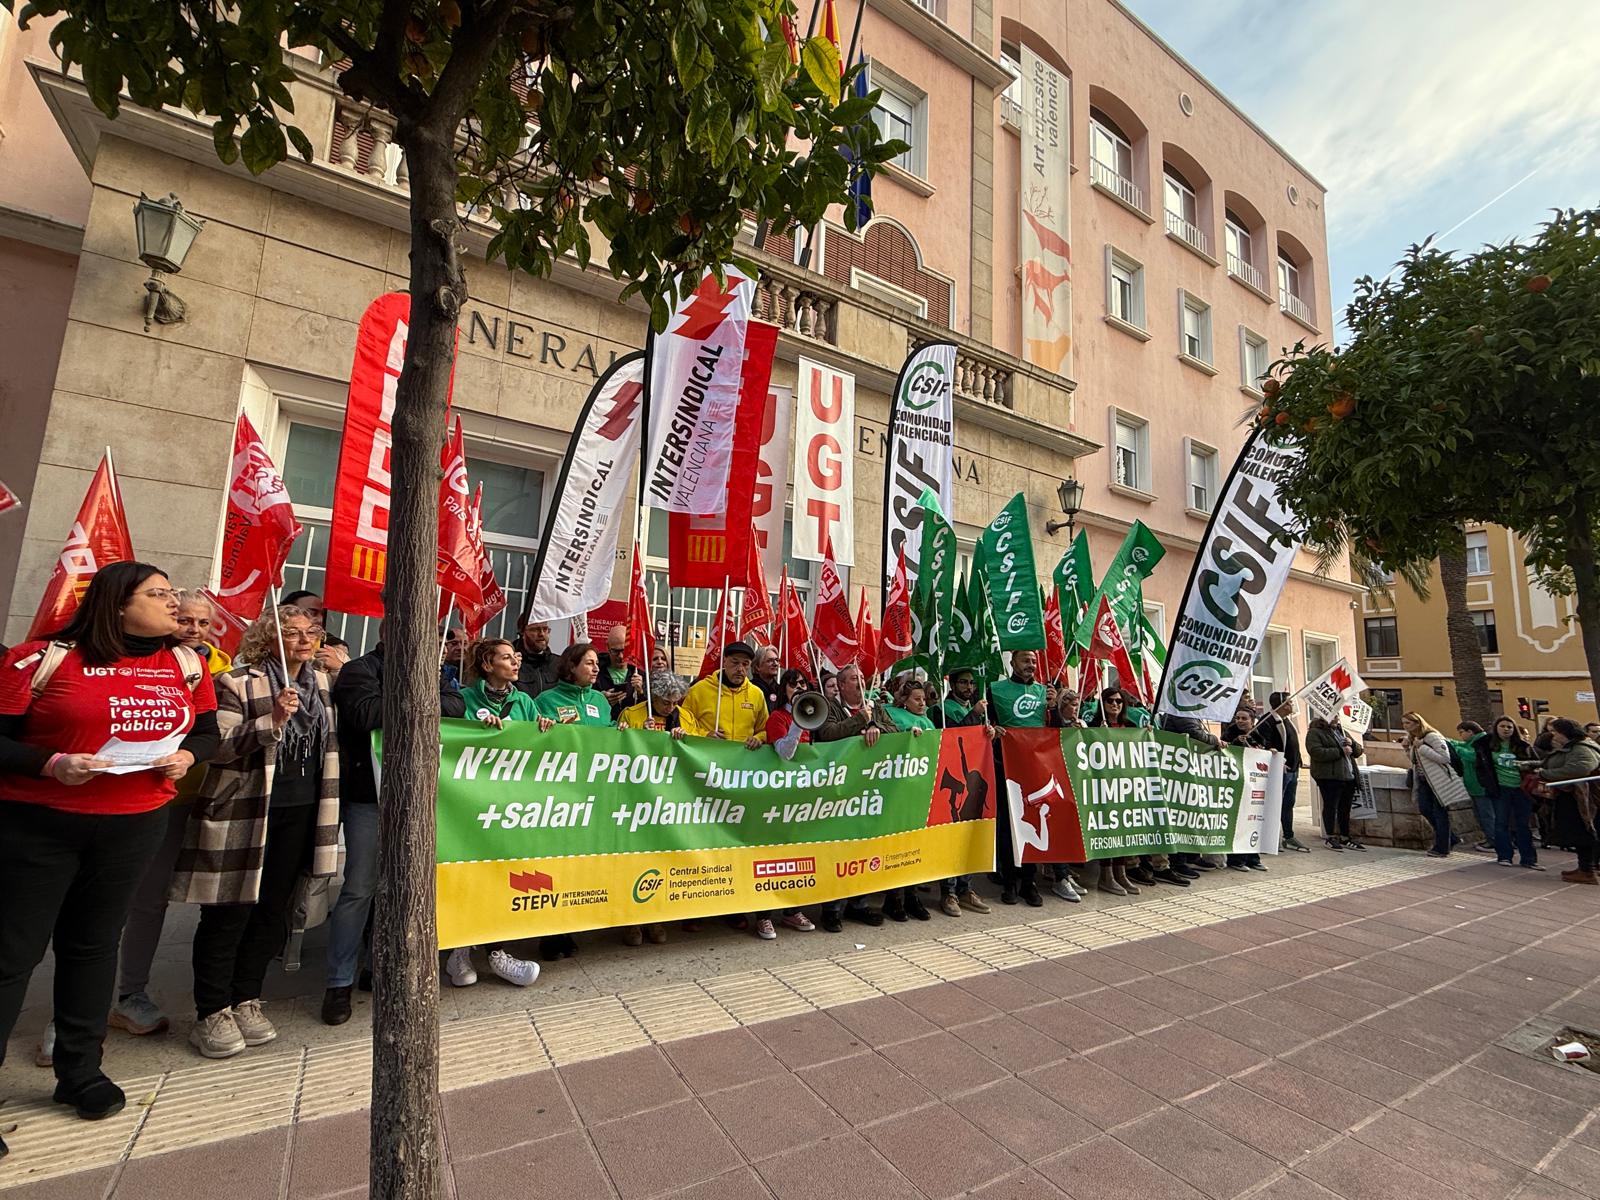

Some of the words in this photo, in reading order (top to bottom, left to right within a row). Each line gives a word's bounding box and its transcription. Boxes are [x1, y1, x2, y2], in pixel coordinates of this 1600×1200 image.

[1032, 60, 1047, 144] rupestre
[1045, 70, 1059, 149] valencià
[1033, 145, 1045, 178] Art
[911, 374, 951, 398] CSIF
[650, 344, 724, 503] INTERSINDICAL
[894, 409, 951, 433] COMUNIDAD
[893, 423, 952, 447] VALENCIANA
[673, 419, 718, 509] VALENCIANA
[807, 367, 843, 554] UGT
[443, 494, 467, 521] País
[554, 457, 614, 593] INTERSINDICAL
[571, 524, 604, 599] VALENCIANA
[1198, 475, 1287, 632] CSIF
[995, 532, 1022, 612] CSIF
[1011, 617, 1029, 627] CSIF
[1178, 614, 1258, 651] COMUNIDAD
[1175, 630, 1251, 667] VALENCIANA
[83, 667, 117, 676] UGT
[1177, 672, 1239, 703] CSIF
[1315, 681, 1342, 706] STEPV
[109, 696, 171, 706] Salvem
[110, 707, 177, 719] l'escola
[1018, 700, 1041, 710] CSIF
[110, 719, 173, 734] pública
[454, 745, 530, 784] N'HI
[534, 748, 578, 784] HA
[587, 747, 676, 786] PROU!
[694, 759, 848, 791] -burocràcia
[861, 752, 930, 780] -ràtios
[1076, 741, 1126, 771] SOM
[1083, 779, 1088, 806] I
[476, 794, 597, 831] +salari
[611, 794, 745, 834] +plantilla
[762, 788, 885, 825] +valencià
[1087, 809, 1119, 831] ALS
[1122, 807, 1167, 828] CENT
[1090, 834, 1125, 850] PERSONAL
[1125, 830, 1162, 848] D'ATENCIÓ
[669, 866, 699, 877] Central
[700, 863, 733, 875] Sindical
[756, 861, 797, 875] CCOO
[836, 859, 868, 878] UGT
[561, 888, 609, 900] INTERSINDICAL
[638, 878, 664, 893] CSIF
[669, 877, 724, 889] Independiente
[669, 892, 680, 902] de
[681, 887, 736, 900] Funcionarios
[755, 874, 817, 892] educació
[511, 893, 560, 912] STEPV
[569, 895, 609, 907] VALENCIANA
